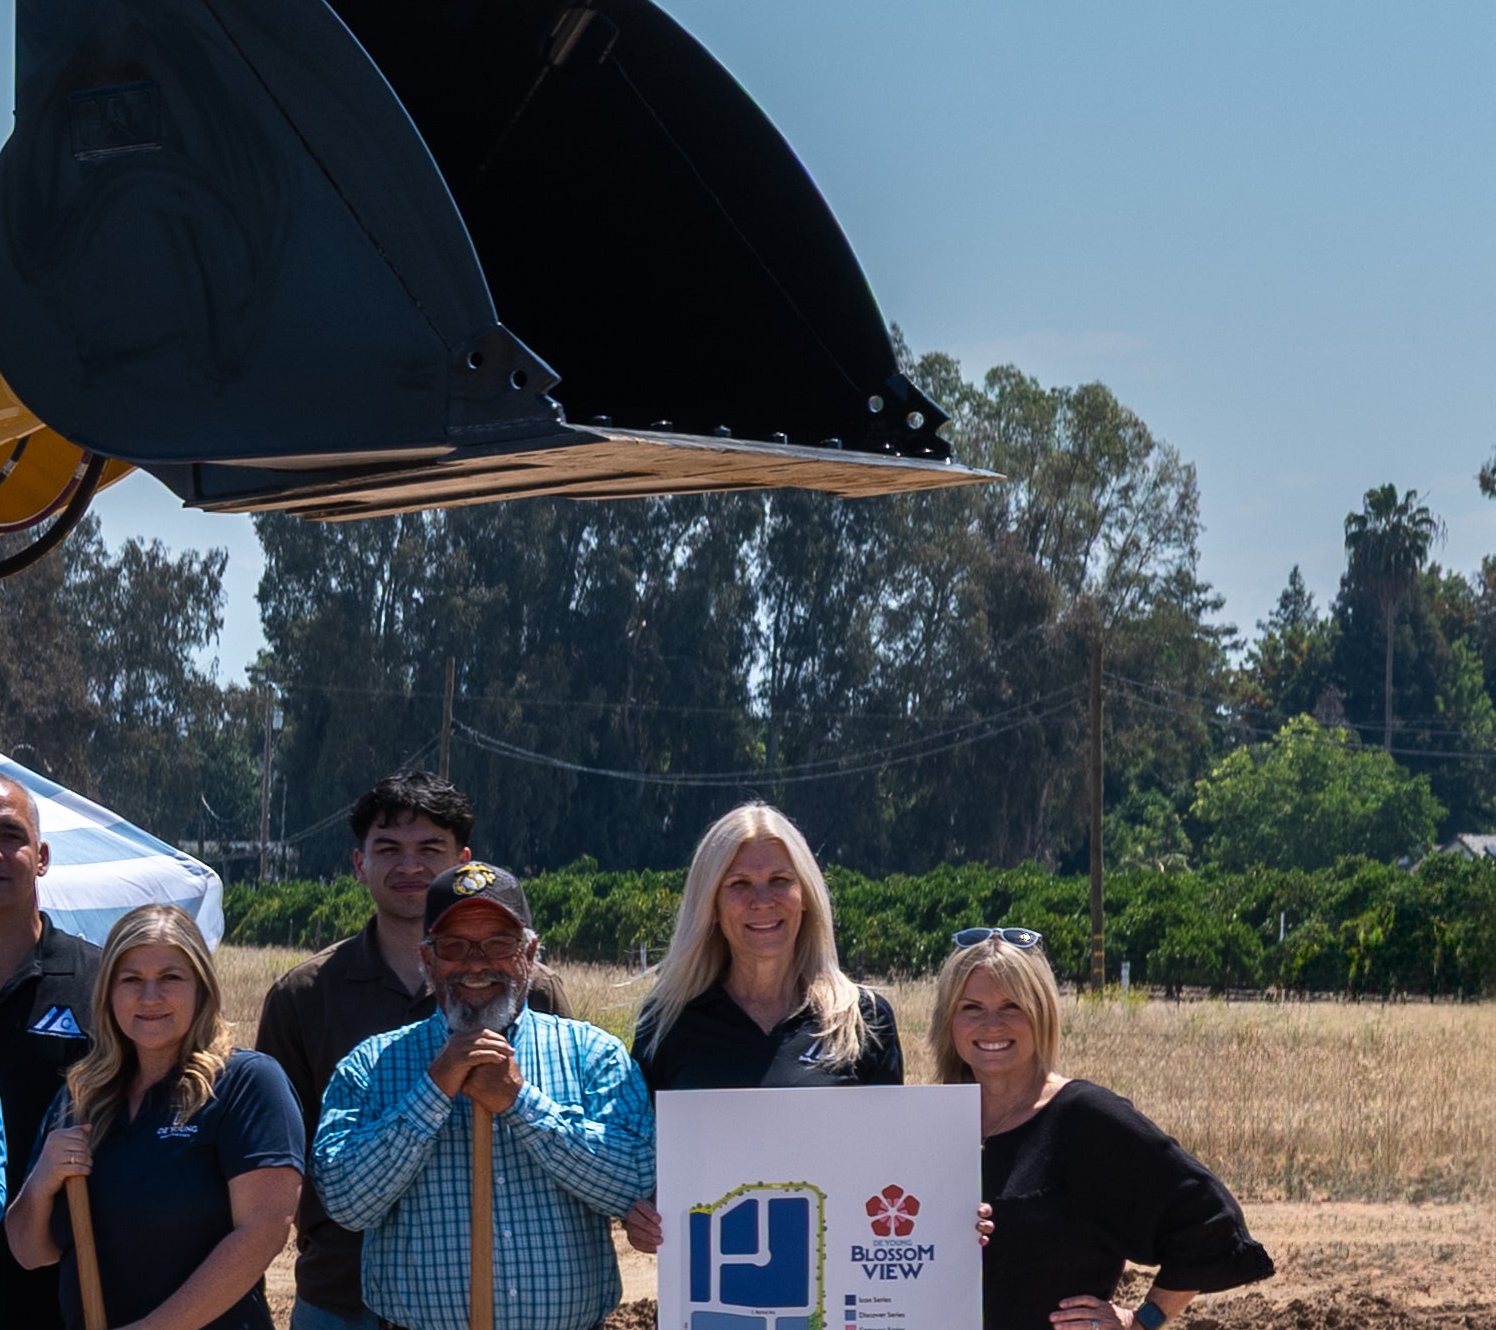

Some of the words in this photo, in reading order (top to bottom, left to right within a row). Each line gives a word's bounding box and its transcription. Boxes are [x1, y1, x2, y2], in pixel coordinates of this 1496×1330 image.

[873, 1239, 882, 1247] DE
[883, 1238, 913, 1247] YOUNG
[861, 1262, 924, 1280] VIEW
